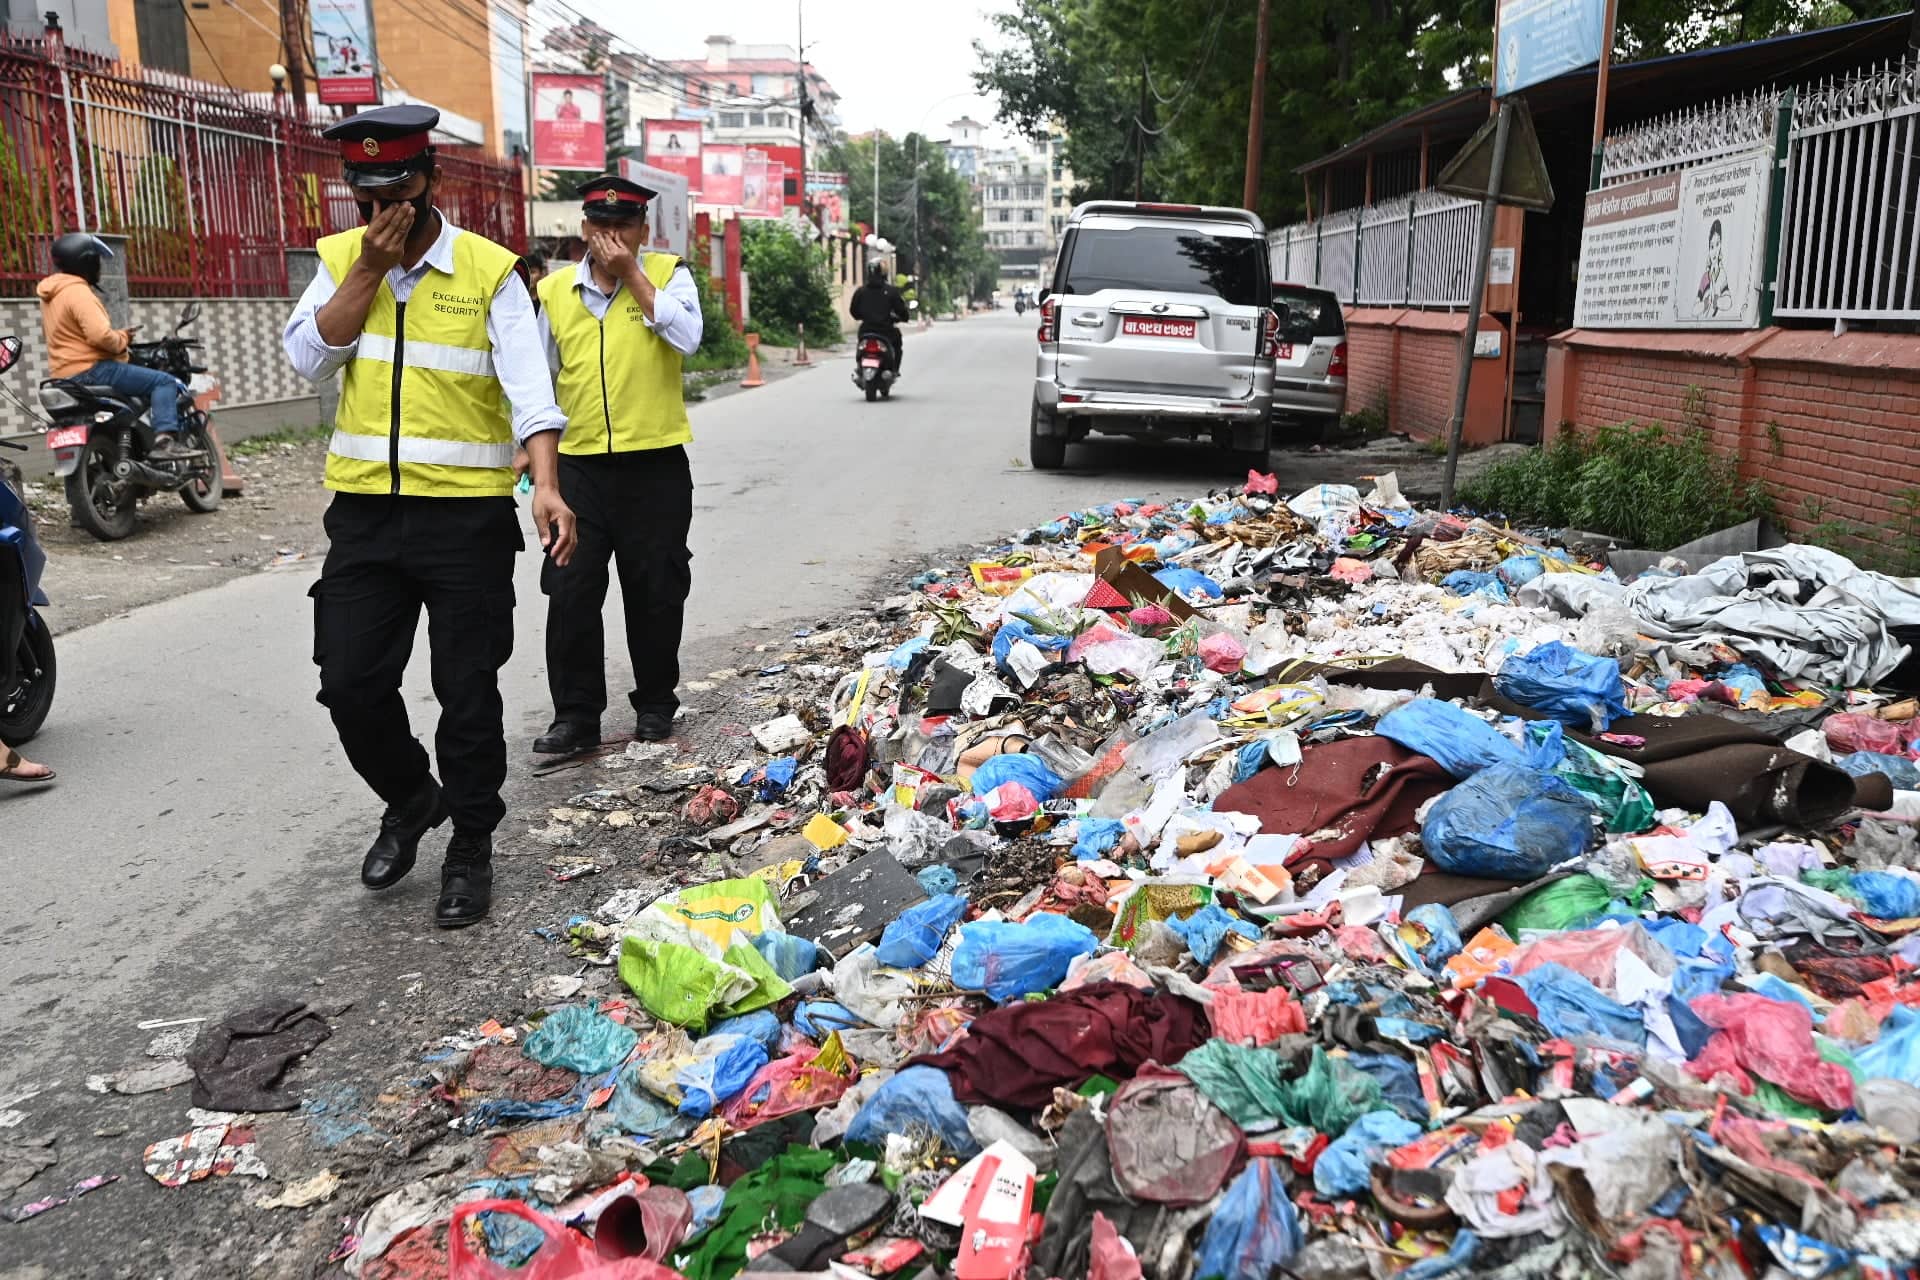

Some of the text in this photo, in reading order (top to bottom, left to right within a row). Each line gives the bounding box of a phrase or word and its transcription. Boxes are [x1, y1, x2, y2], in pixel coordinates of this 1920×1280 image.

[432, 291, 484, 306] EXCELLENT
[434, 303, 479, 317] SECURITY
[985, 1237, 1010, 1248] KFC
